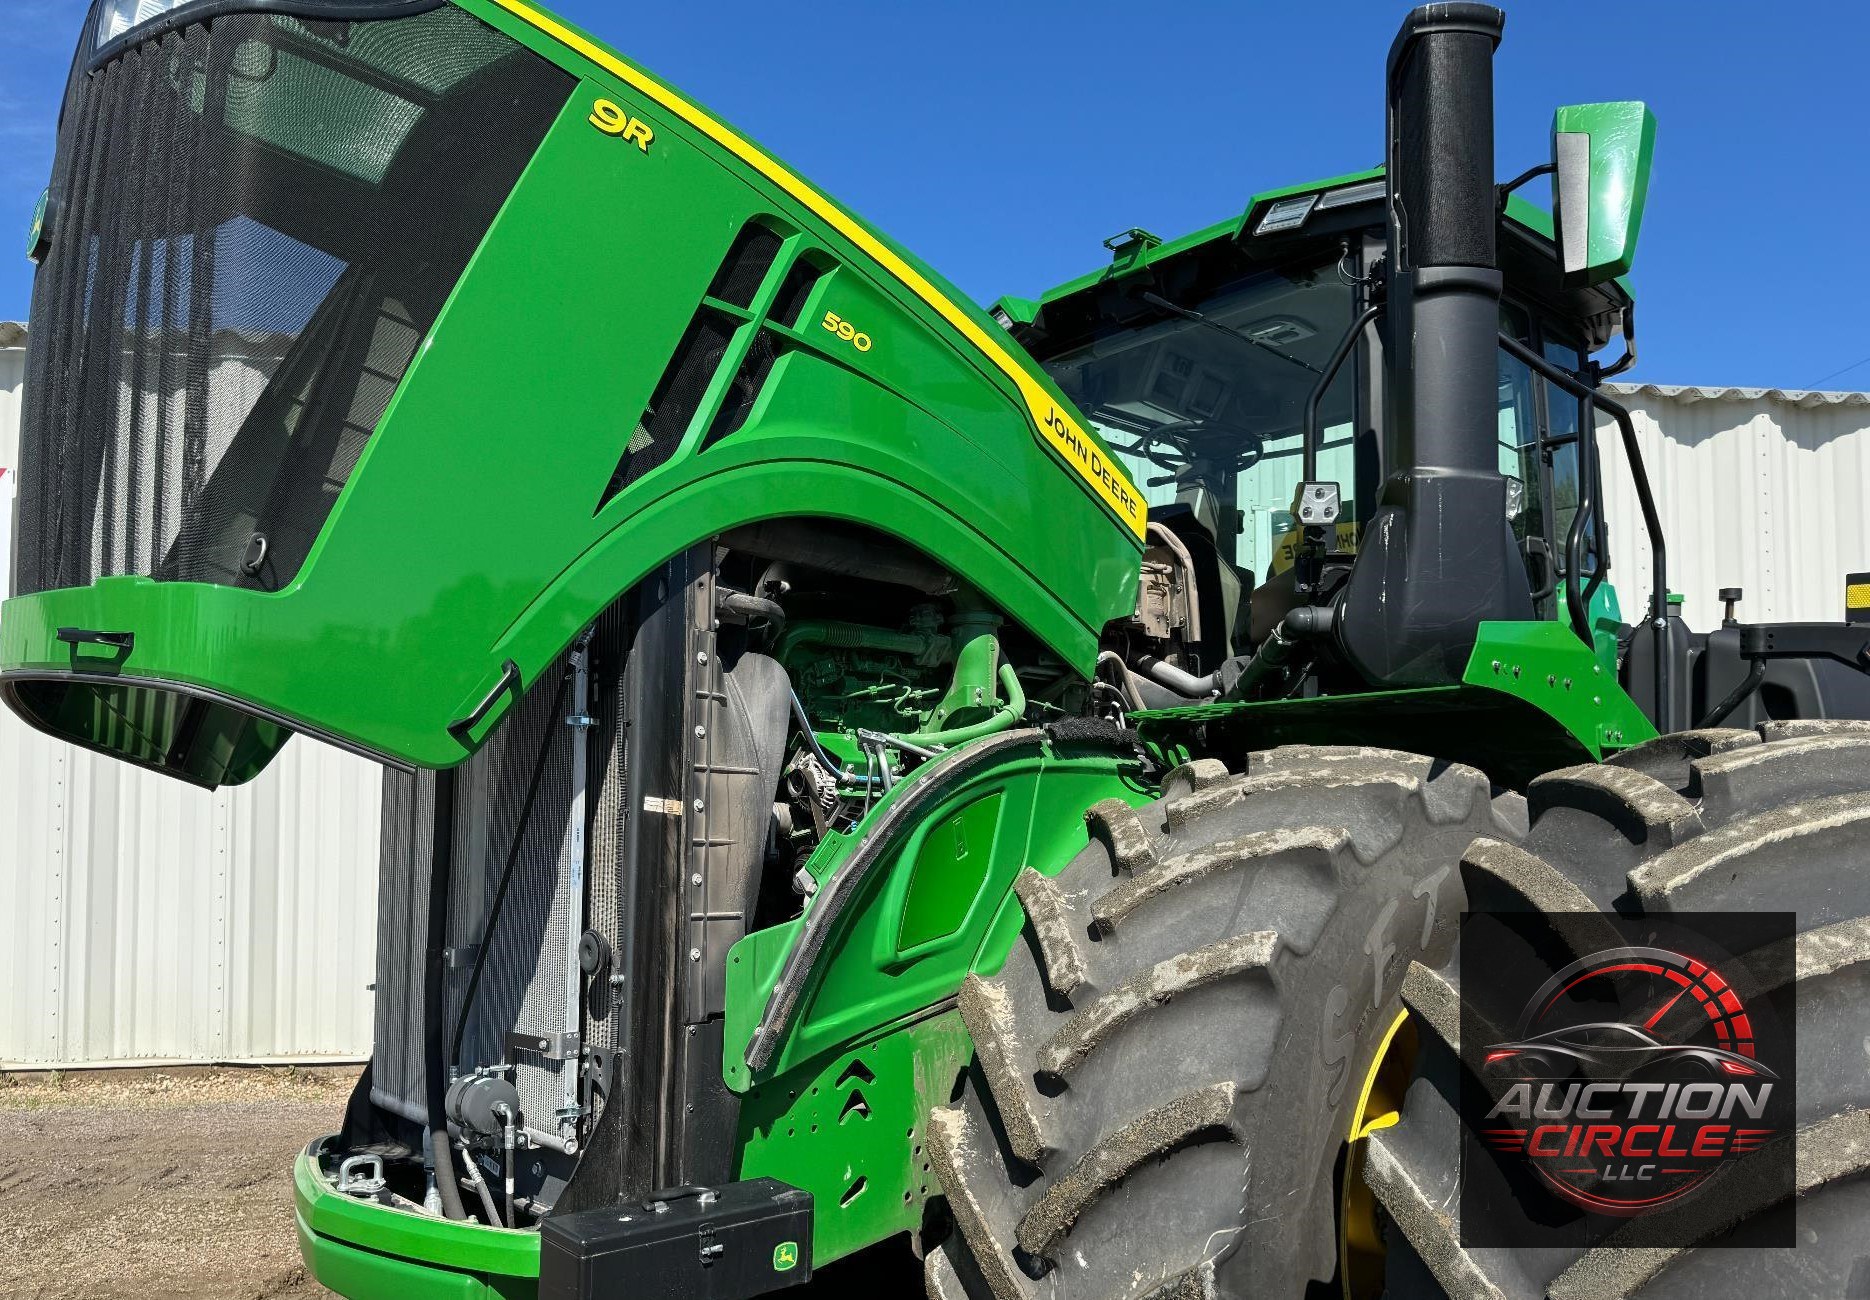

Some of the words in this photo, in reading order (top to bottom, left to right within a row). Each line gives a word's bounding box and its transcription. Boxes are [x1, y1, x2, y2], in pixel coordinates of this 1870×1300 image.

[588, 98, 654, 154] 9R
[821, 310, 872, 352] 590
[1044, 406, 1088, 464] JOHN
[1091, 451, 1137, 519] DEERE
